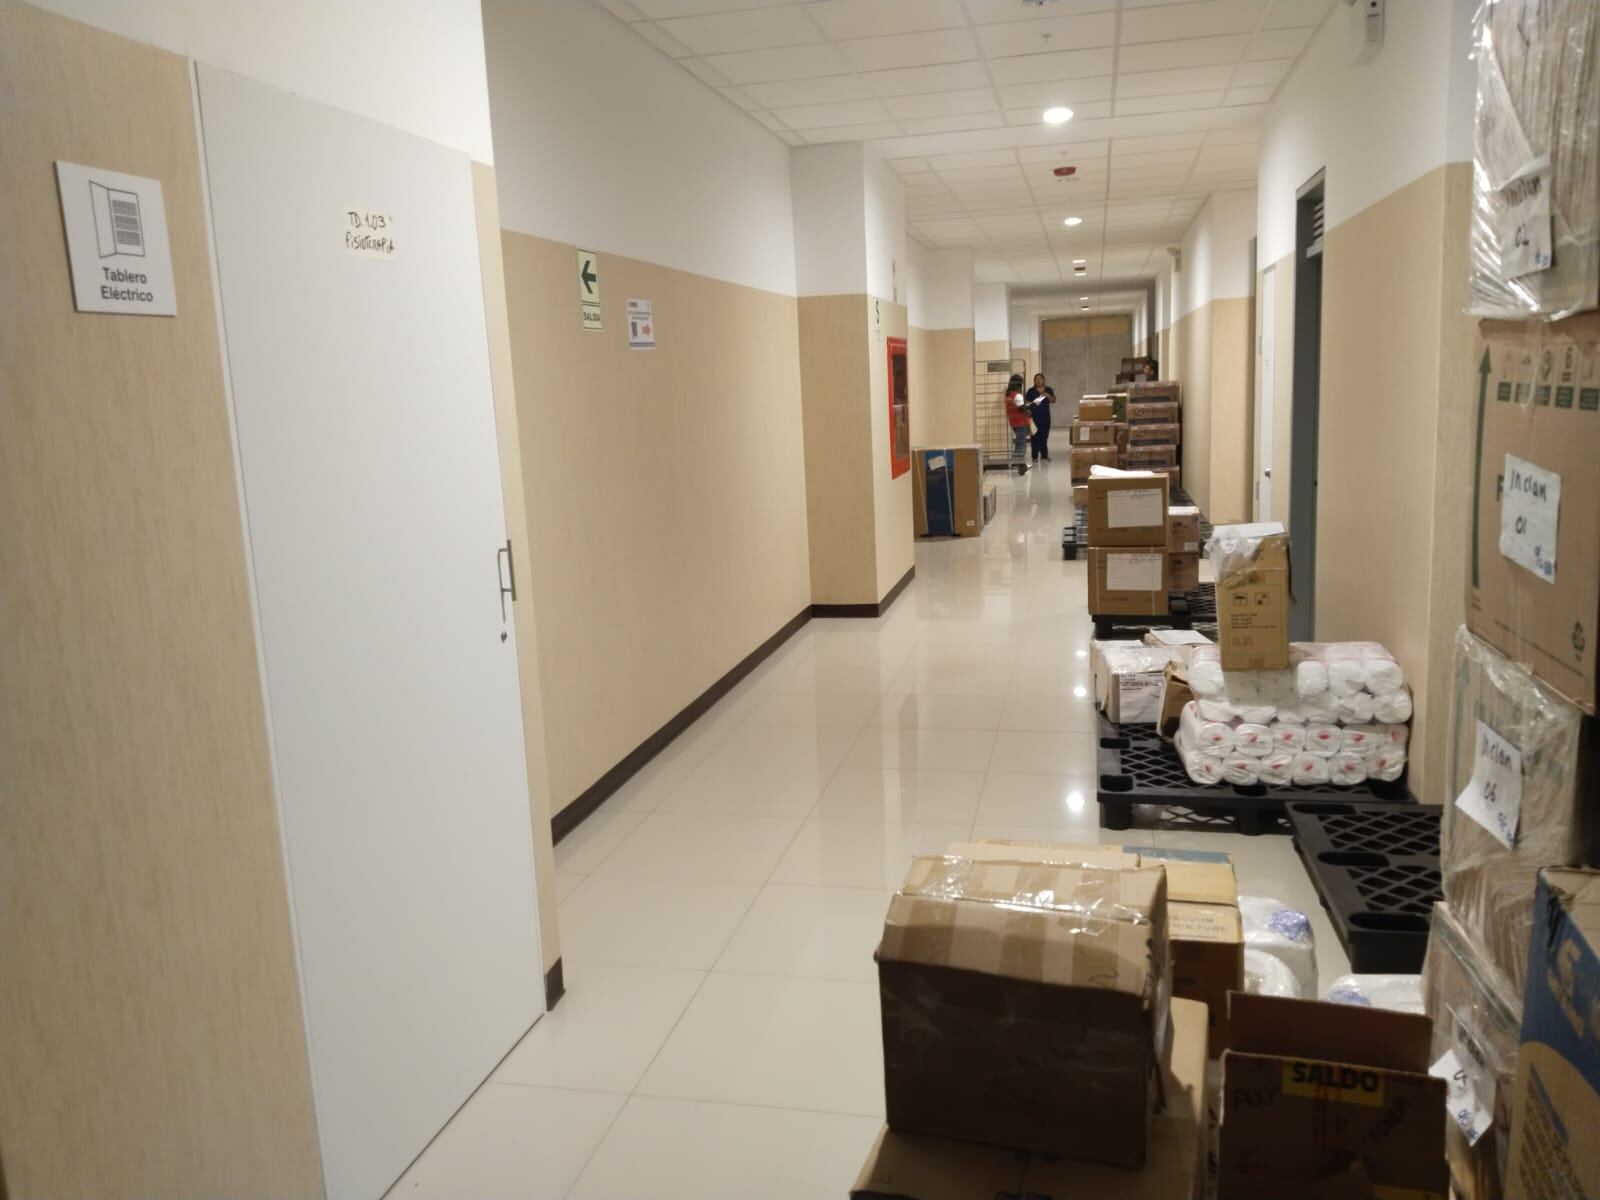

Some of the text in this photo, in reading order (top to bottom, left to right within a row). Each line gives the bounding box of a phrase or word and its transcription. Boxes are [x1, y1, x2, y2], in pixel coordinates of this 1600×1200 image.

[102, 266, 148, 284] Tablero
[100, 285, 154, 302] Eléctrico
[583, 311, 601, 322] SALIDA
[1291, 1061, 1379, 1093] SALDO
